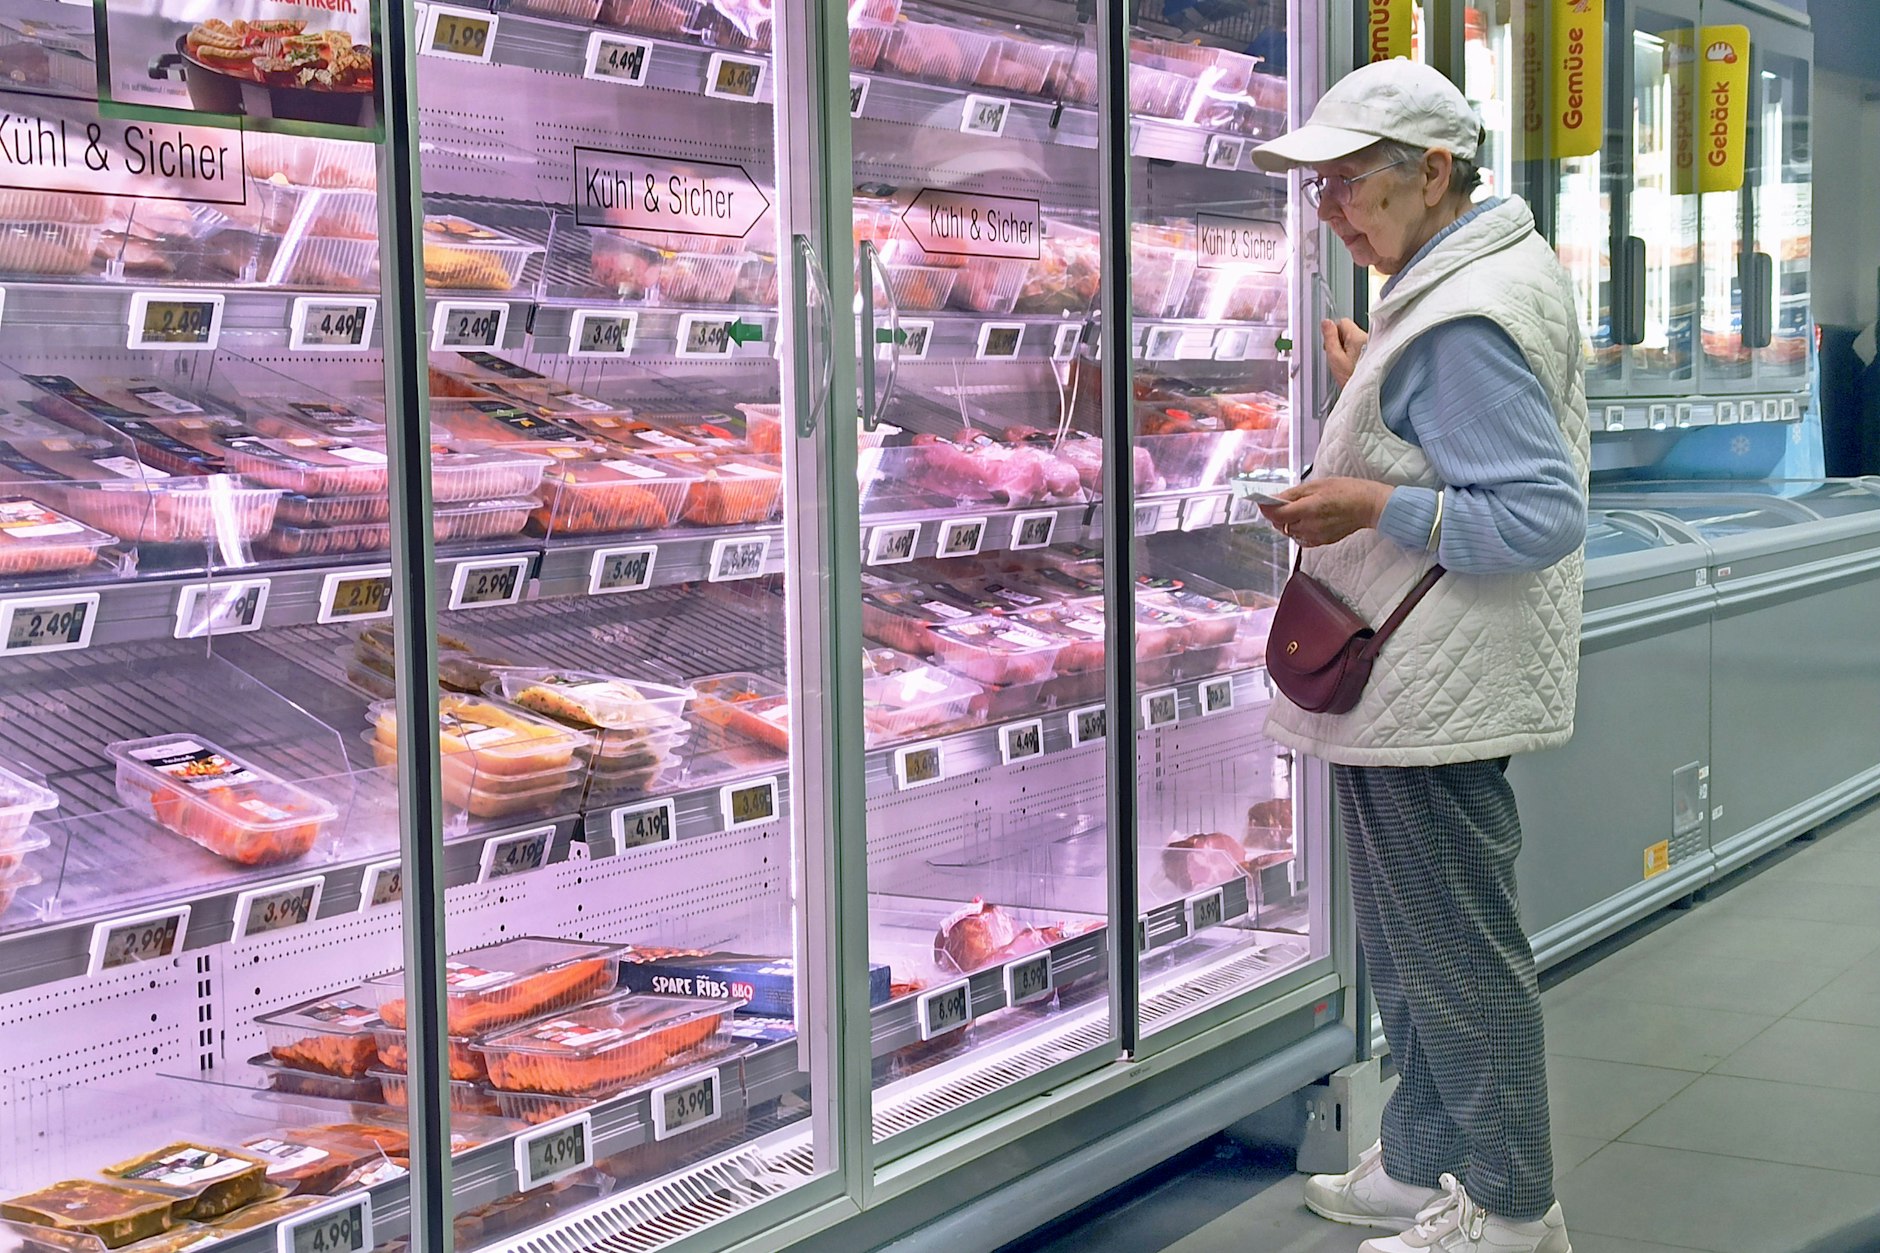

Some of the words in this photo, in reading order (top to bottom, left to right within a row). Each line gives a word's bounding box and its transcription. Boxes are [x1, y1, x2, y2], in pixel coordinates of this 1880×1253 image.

[447, 23, 487, 52] 1.99
[608, 48, 636, 71] 4.49
[1562, 27, 1585, 130] Gemüse
[1708, 80, 1731, 168] Gebäck
[0, 114, 68, 168] Kühl
[84, 123, 110, 171] &
[124, 126, 229, 182] Sicher
[585, 166, 635, 212] Kühl
[643, 174, 661, 213] &
[668, 175, 735, 220] Sicher
[929, 204, 964, 239] Kühl
[970, 209, 983, 240] &
[986, 209, 1034, 246] Sicher
[1201, 225, 1227, 255] Kühl
[1230, 231, 1239, 257] &
[1242, 231, 1276, 262] Sicher
[162, 310, 201, 334] 2.49
[320, 313, 356, 337] 4.49
[458, 317, 490, 338] 2.49
[593, 326, 621, 343] 3.49
[698, 327, 724, 346] 3.49
[901, 331, 921, 348] .49
[612, 559, 641, 579] 5.49
[350, 583, 382, 606] 2.19
[477, 574, 508, 595] 2.99
[30, 613, 73, 637] 2.49
[1016, 733, 1035, 750] 4.49
[636, 818, 661, 838] 4.19
[506, 842, 536, 866] 4.19
[264, 897, 299, 920] 3.99
[125, 929, 163, 954] 2.99
[652, 976, 692, 994] SPARE
[696, 975, 729, 998] RIBS
[731, 983, 753, 1000] BBQ
[1023, 967, 1042, 989] 8.99
[939, 999, 961, 1021] 6.99
[677, 1091, 707, 1118] 3.99
[544, 1137, 575, 1165] 4.99
[313, 1221, 352, 1252] 4.99
